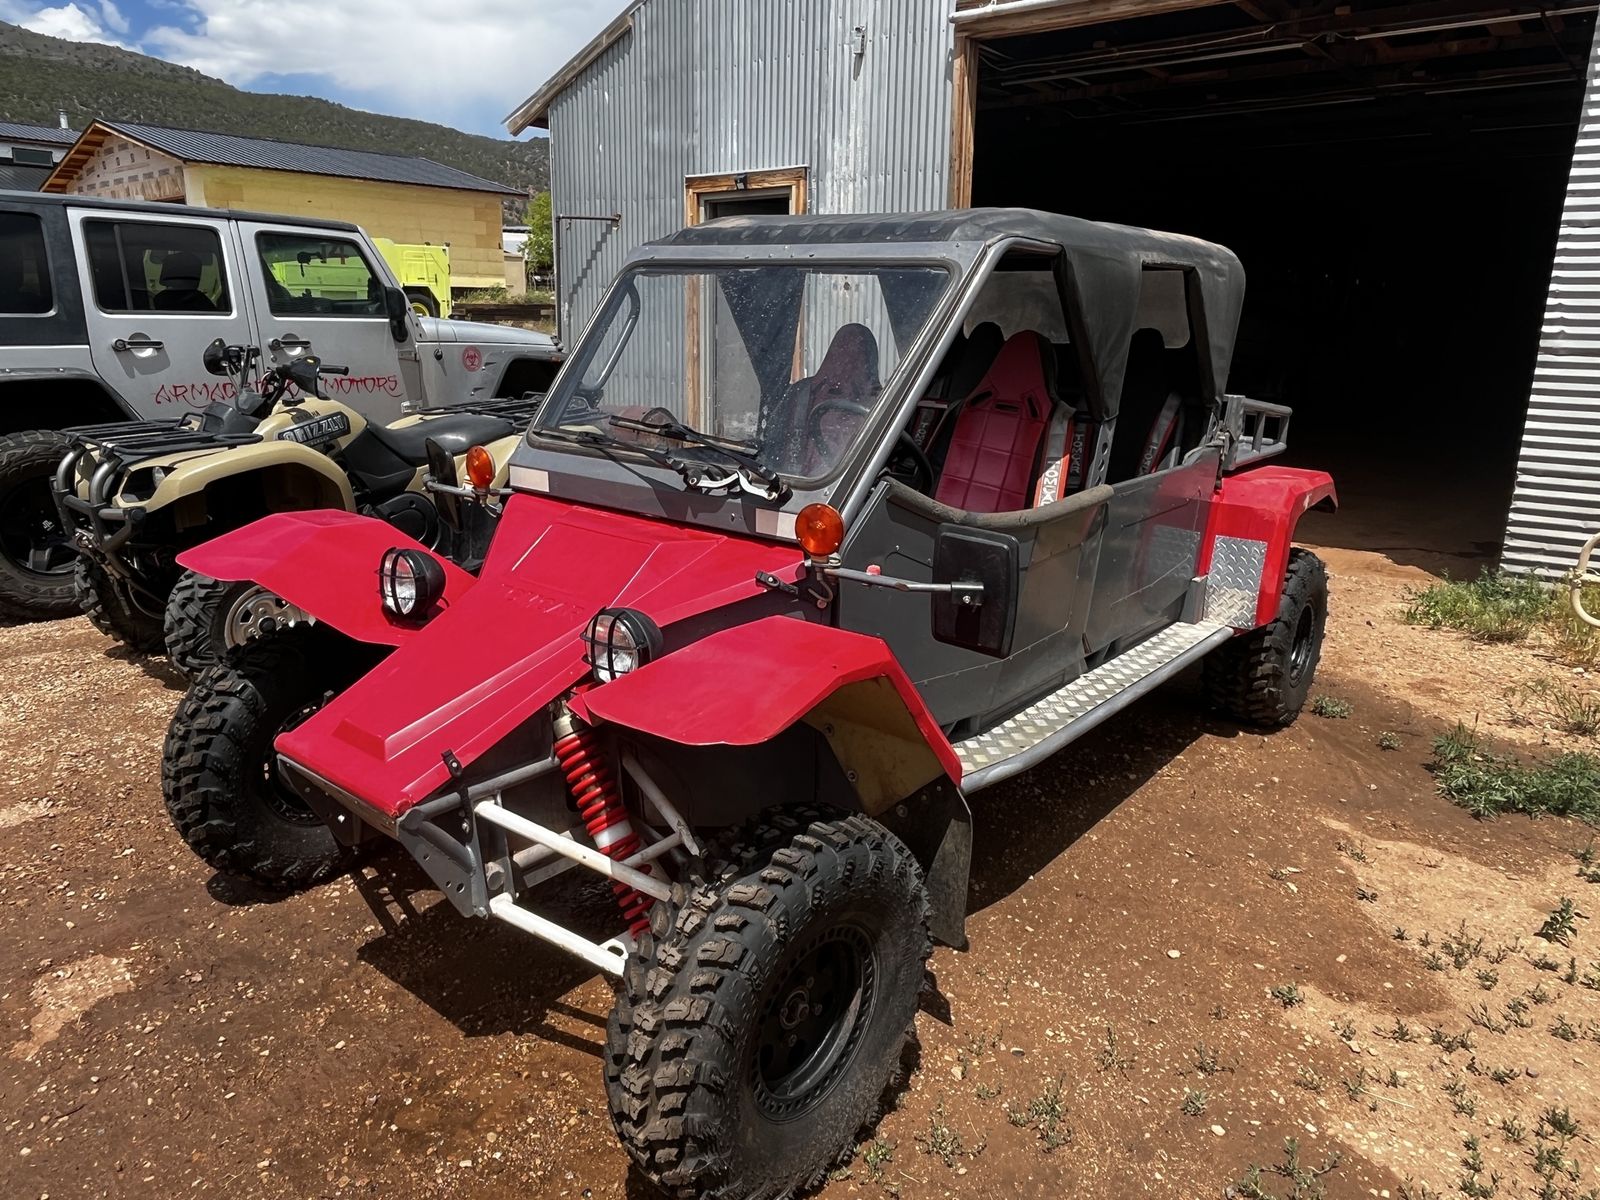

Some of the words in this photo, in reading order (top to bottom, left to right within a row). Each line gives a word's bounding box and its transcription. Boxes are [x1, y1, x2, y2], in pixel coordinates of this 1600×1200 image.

[324, 375, 402, 397] MOTORS
[1070, 433, 1085, 473] TOMCAR
[1040, 460, 1061, 506] TOMCA
